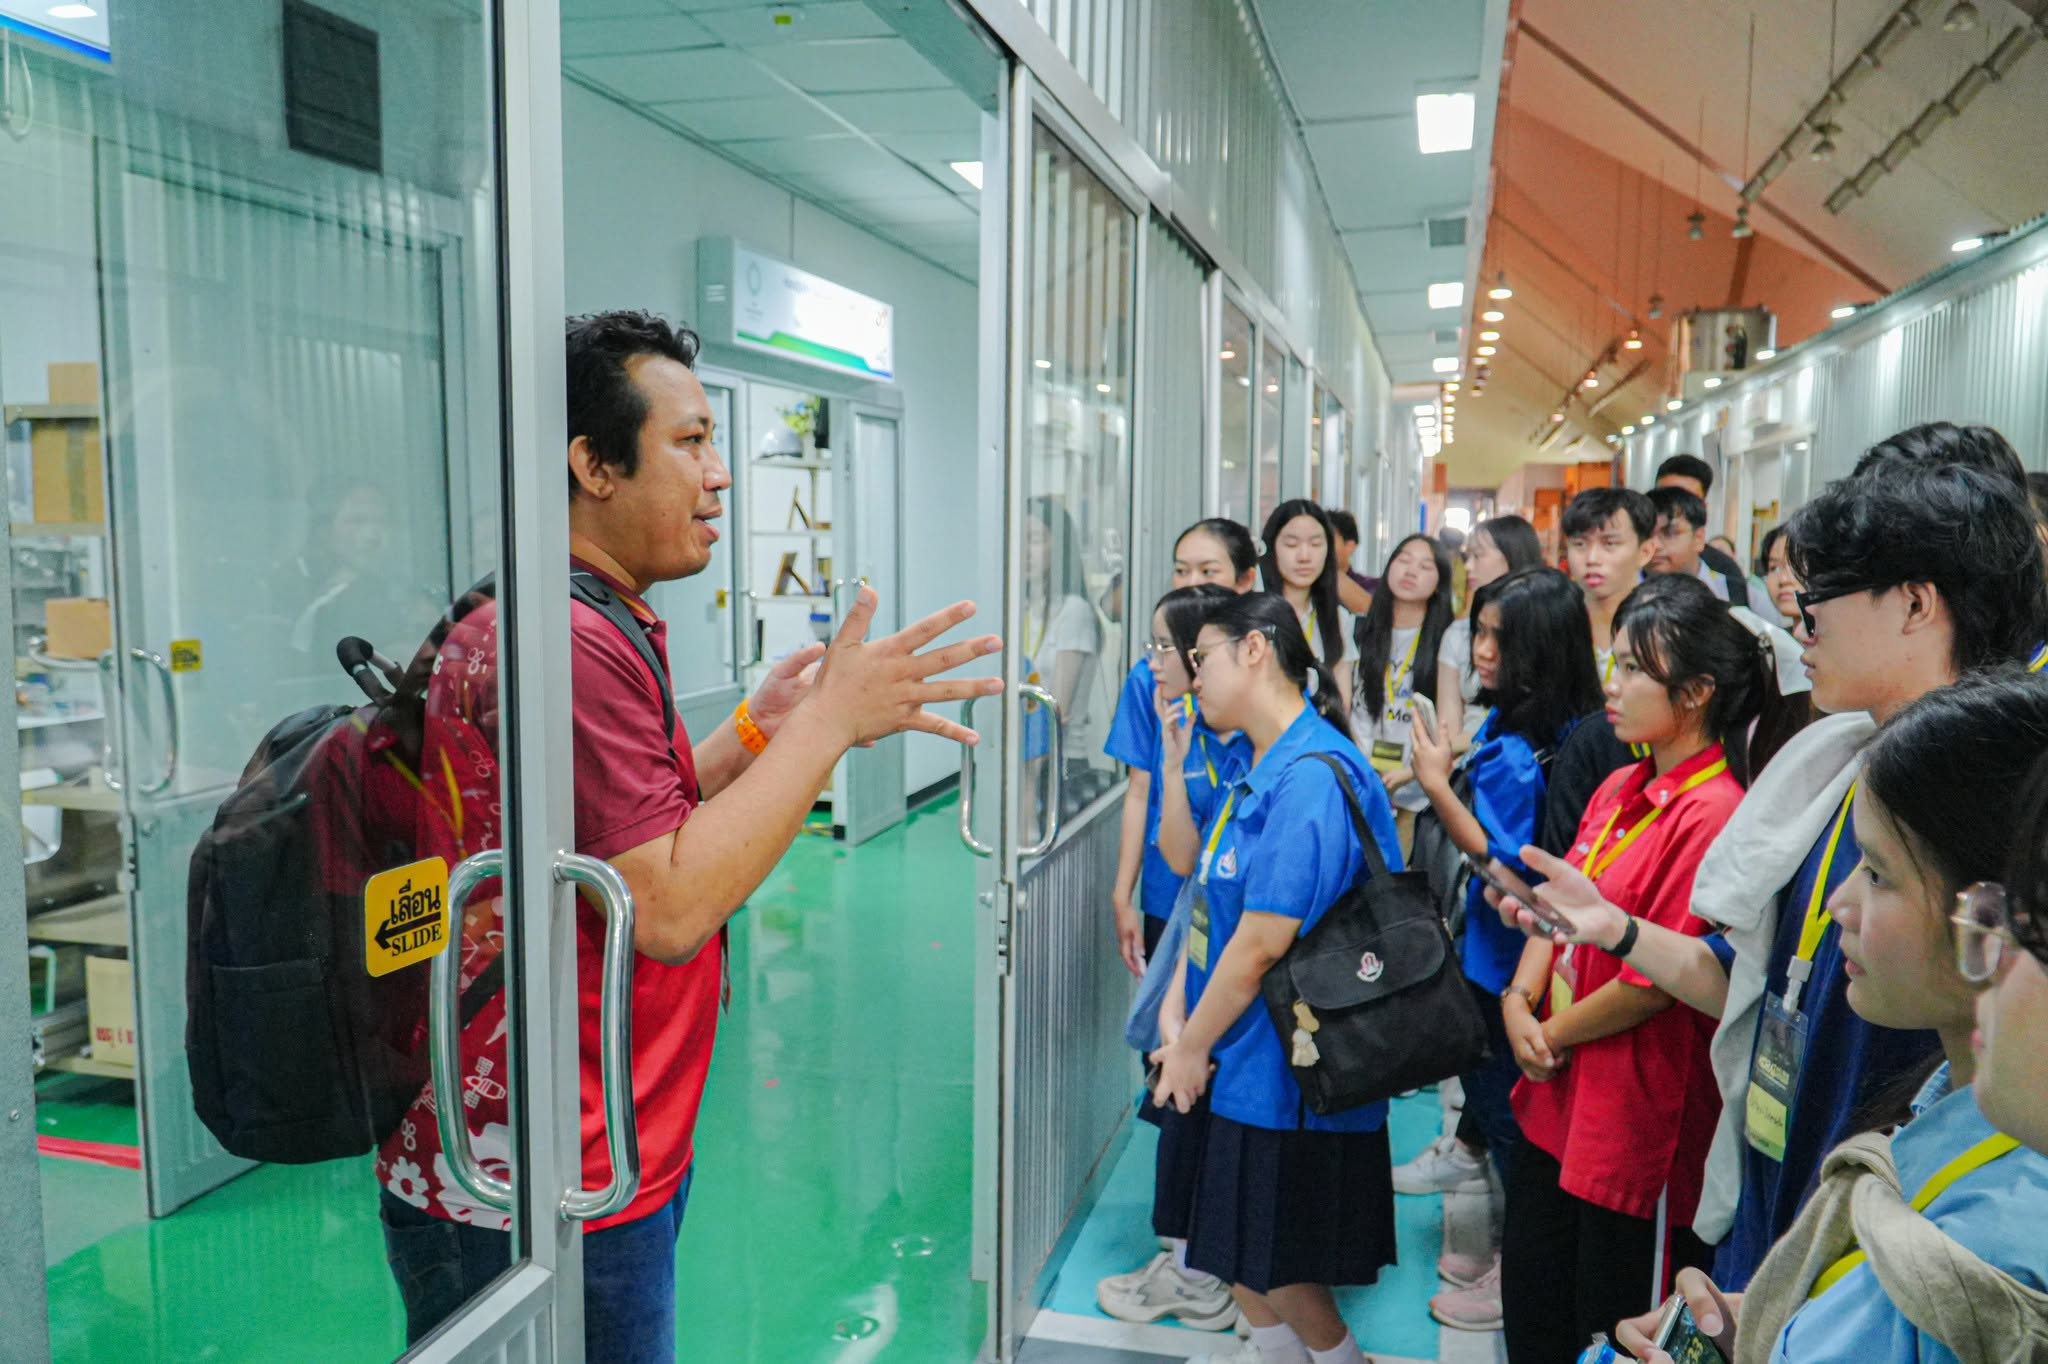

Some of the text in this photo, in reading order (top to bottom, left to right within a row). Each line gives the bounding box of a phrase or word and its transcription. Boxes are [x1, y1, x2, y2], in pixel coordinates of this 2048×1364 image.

[390, 878, 442, 925] เลื่อน
[391, 923, 442, 957] SLIDE
